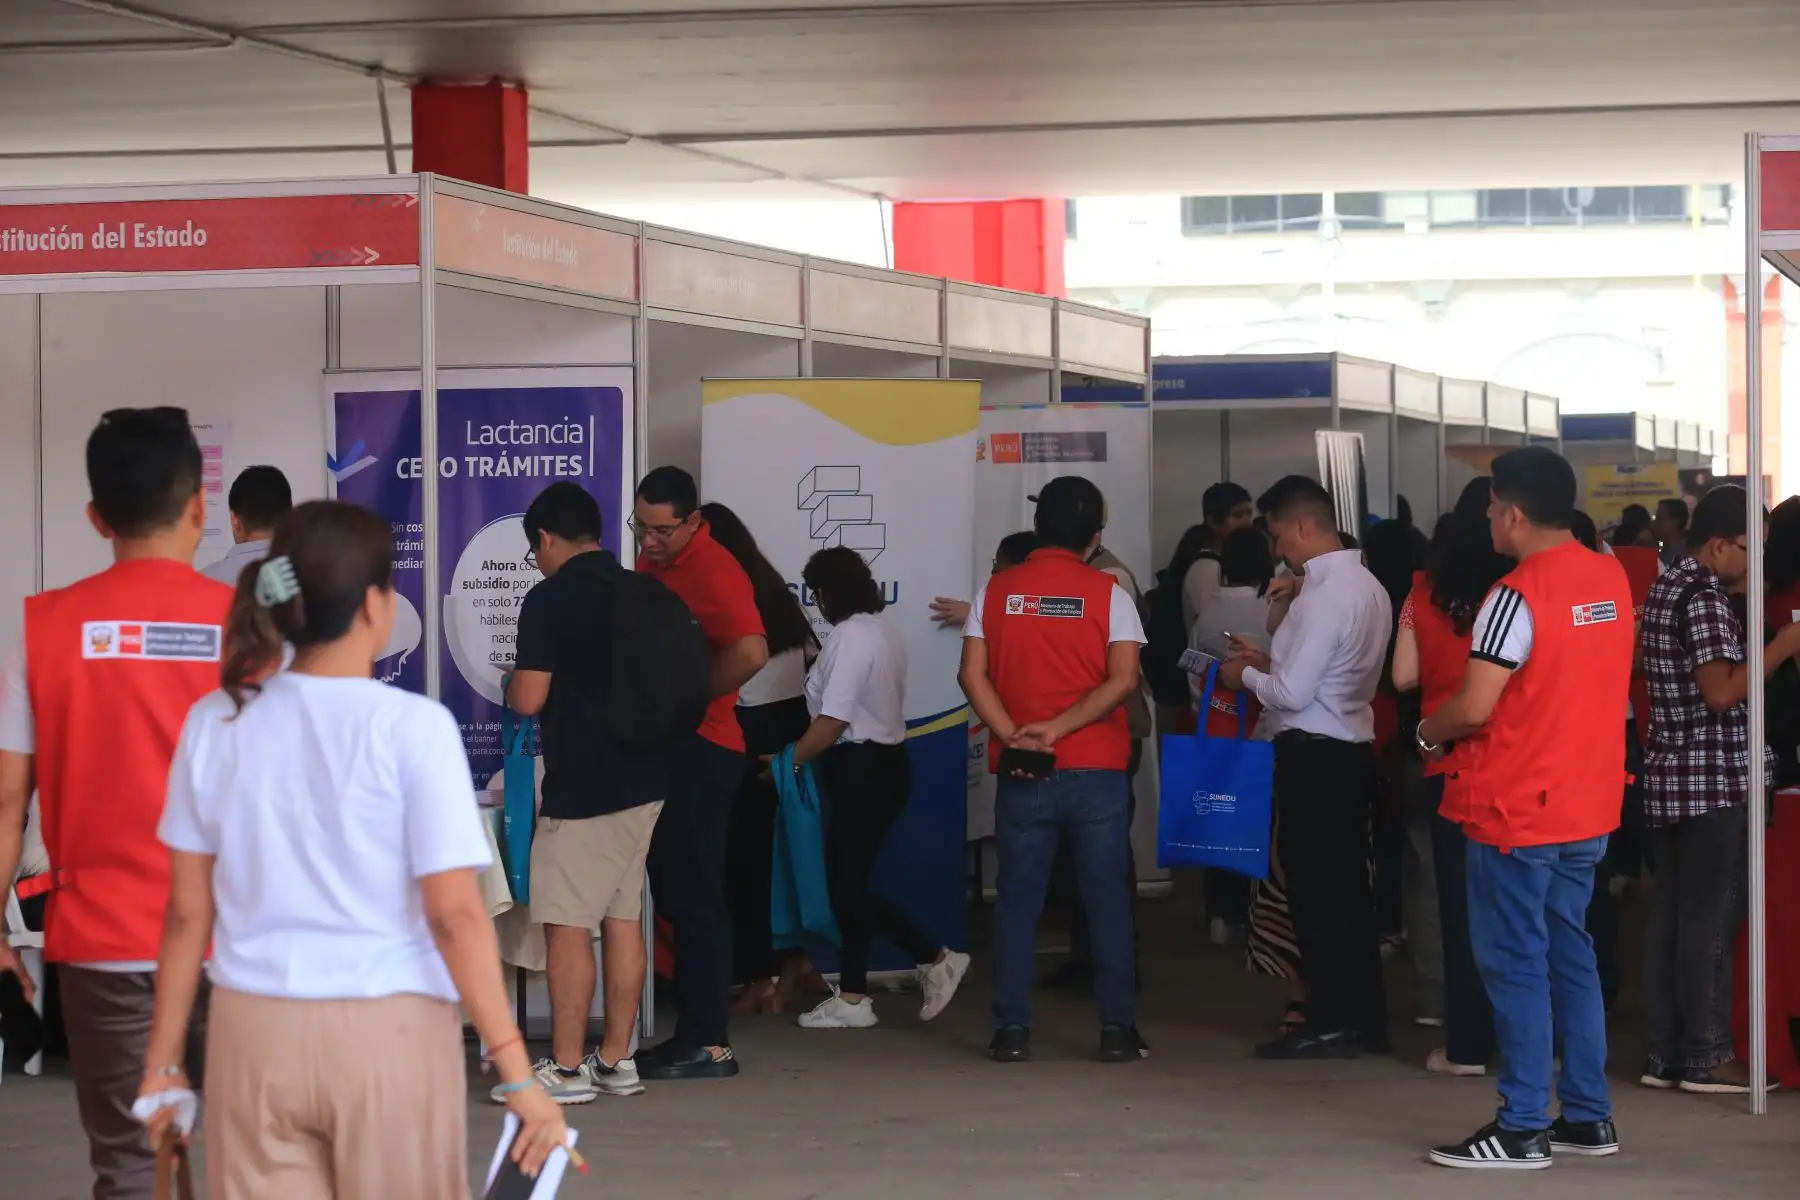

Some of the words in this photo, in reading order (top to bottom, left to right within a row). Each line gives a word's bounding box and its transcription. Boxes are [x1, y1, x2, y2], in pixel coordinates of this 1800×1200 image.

[0, 224, 84, 252] titución
[91, 222, 126, 249] del
[134, 219, 207, 248] Estado
[466, 415, 584, 446] Lactancia
[396, 455, 459, 479] CEO
[464, 450, 583, 478] TRÁMITES
[406, 522, 424, 533] cos
[396, 539, 424, 551] trámi
[481, 560, 517, 571] Ahora
[462, 577, 510, 590] subsidio
[512, 580, 531, 595] por
[473, 598, 485, 608] en
[487, 595, 512, 608] solo
[480, 613, 518, 626] hábiles
[489, 650, 503, 661] de
